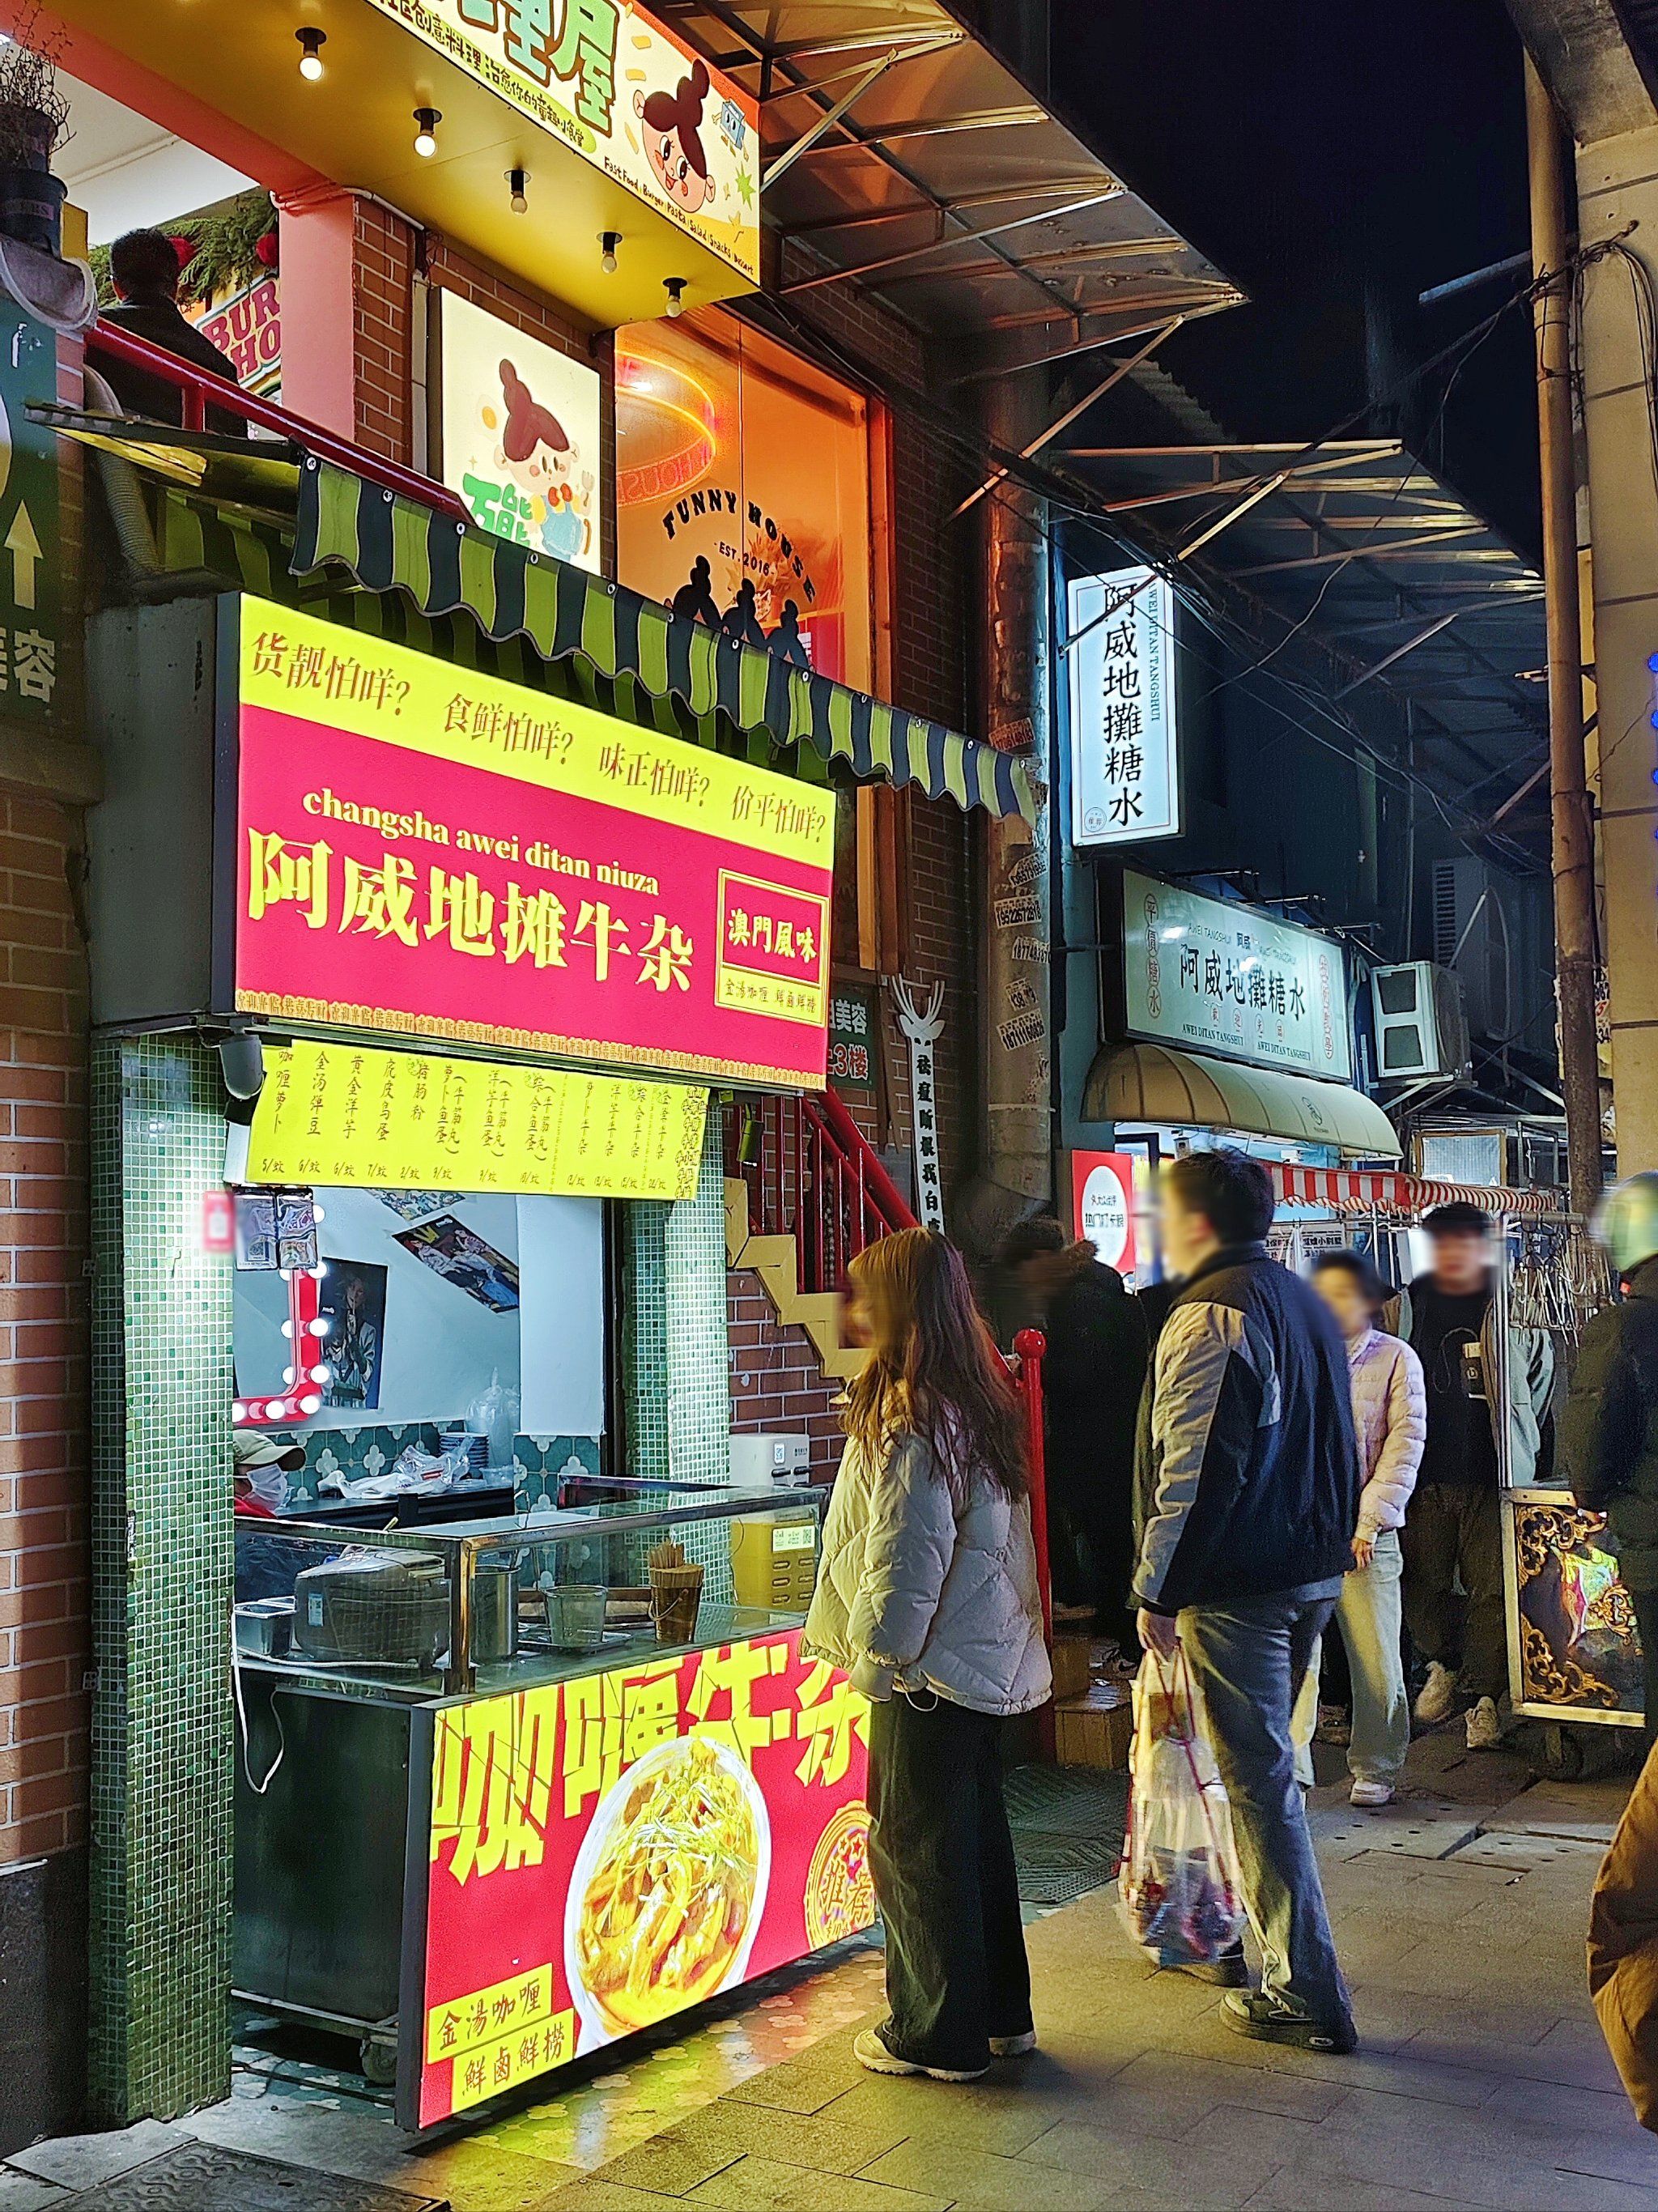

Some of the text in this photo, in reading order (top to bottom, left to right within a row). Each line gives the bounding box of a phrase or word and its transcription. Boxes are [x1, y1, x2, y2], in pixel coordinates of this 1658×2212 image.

[623, 172, 639, 190] Food
[643, 184, 665, 208] Burger
[667, 203, 687, 225] Pasta
[690, 219, 708, 241] Salad
[662, 487, 817, 603] FUNNY HOUSE
[0, 627, 56, 703] 容
[1150, 656, 1161, 721] TANGSHUI
[1103, 581, 1145, 827] 阿威地攤糖水
[302, 789, 661, 898] changsha awei ditan niuza
[246, 827, 696, 993] 阿威地摊牛杂
[727, 907, 818, 963] 澳門風味
[1180, 943, 1305, 1021] 阿威地攤糖水
[1182, 1024, 1197, 1036] AWEI
[437, 1976, 543, 2050] 金湯咖喱
